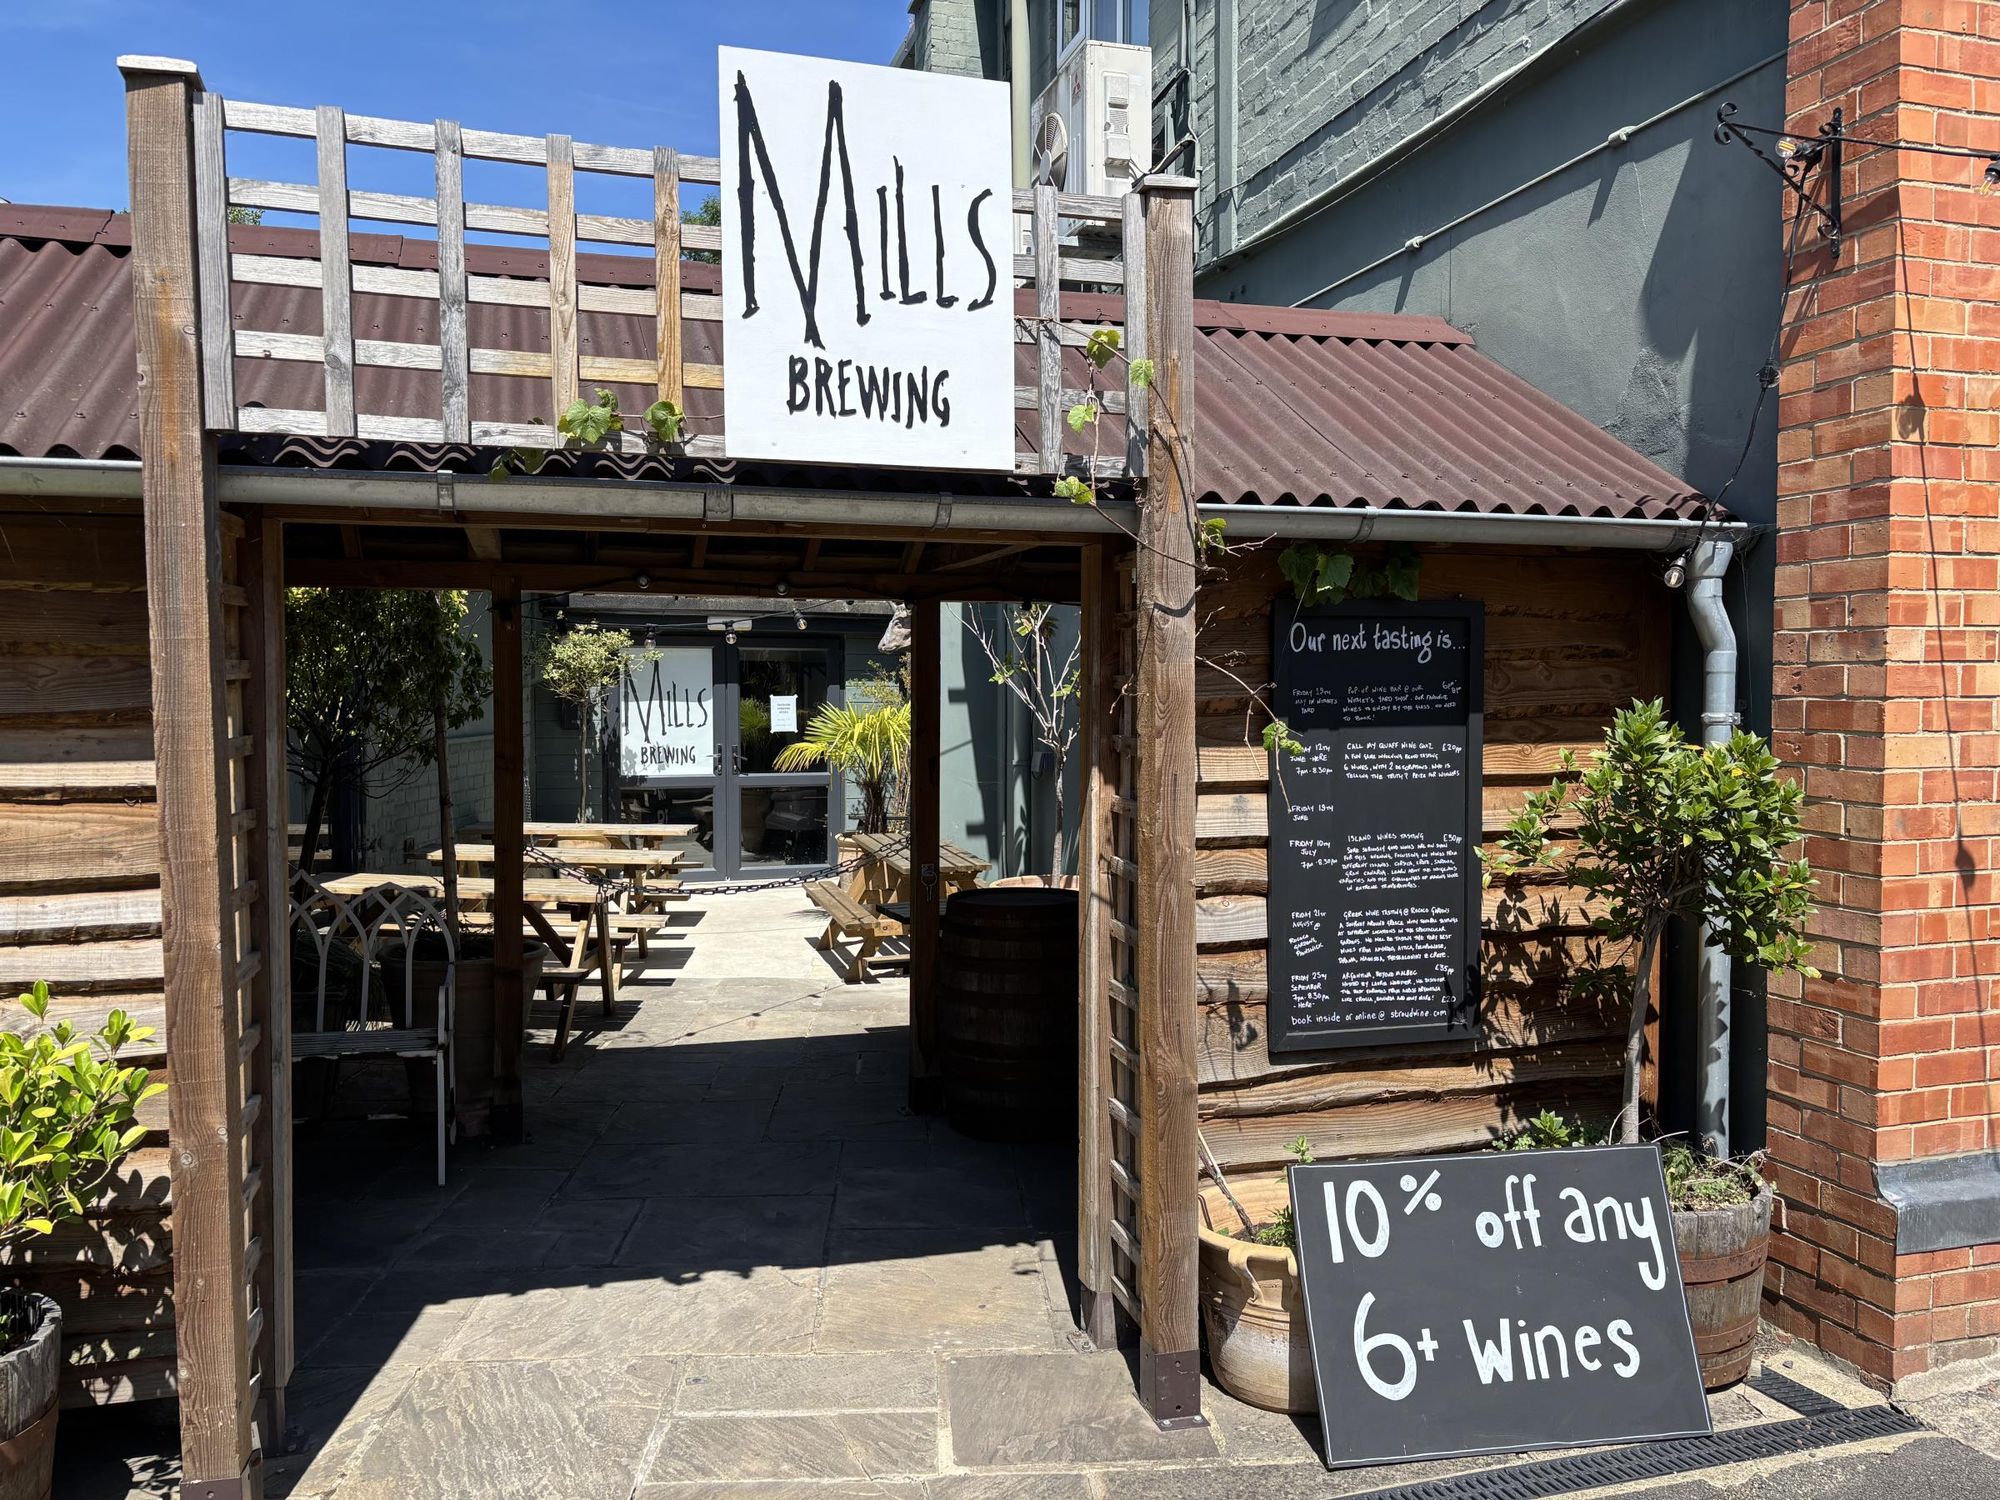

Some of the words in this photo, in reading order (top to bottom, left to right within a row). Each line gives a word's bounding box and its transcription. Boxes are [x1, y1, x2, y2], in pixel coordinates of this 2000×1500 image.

[734, 69, 997, 350] MILLS
[786, 354, 950, 429] BREWING
[1290, 622, 1325, 653] Our
[1333, 624, 1367, 651] next
[1373, 623, 1432, 664] tasting
[623, 659, 708, 744] MILLS
[1347, 742, 1364, 750] CALL
[1367, 742, 1377, 750] MY
[1401, 741, 1417, 749] WINE
[640, 743, 696, 766] BREWING
[1389, 762, 1394, 770] 2
[1348, 834, 1371, 842] ISLAND
[1289, 840, 1314, 848] FRIDAY
[1301, 848, 1317, 857] JULY
[1291, 910, 1311, 919] FRIDAY
[1344, 910, 1363, 920] GREEK
[1293, 920, 1314, 928] AUGUST
[1291, 974, 1309, 983] FRIDAY
[1291, 1014, 1313, 1025] book
[1316, 1012, 1341, 1023] inside
[1345, 1013, 1354, 1021] or
[1355, 1011, 1377, 1021] online
[1378, 1010, 1385, 1021] @
[1323, 1169, 1443, 1264] 10%
[1476, 1173, 1542, 1250] off
[1558, 1187, 1667, 1291] any
[1353, 1291, 1440, 1401] 6+
[1462, 1318, 1641, 1385] Wines
